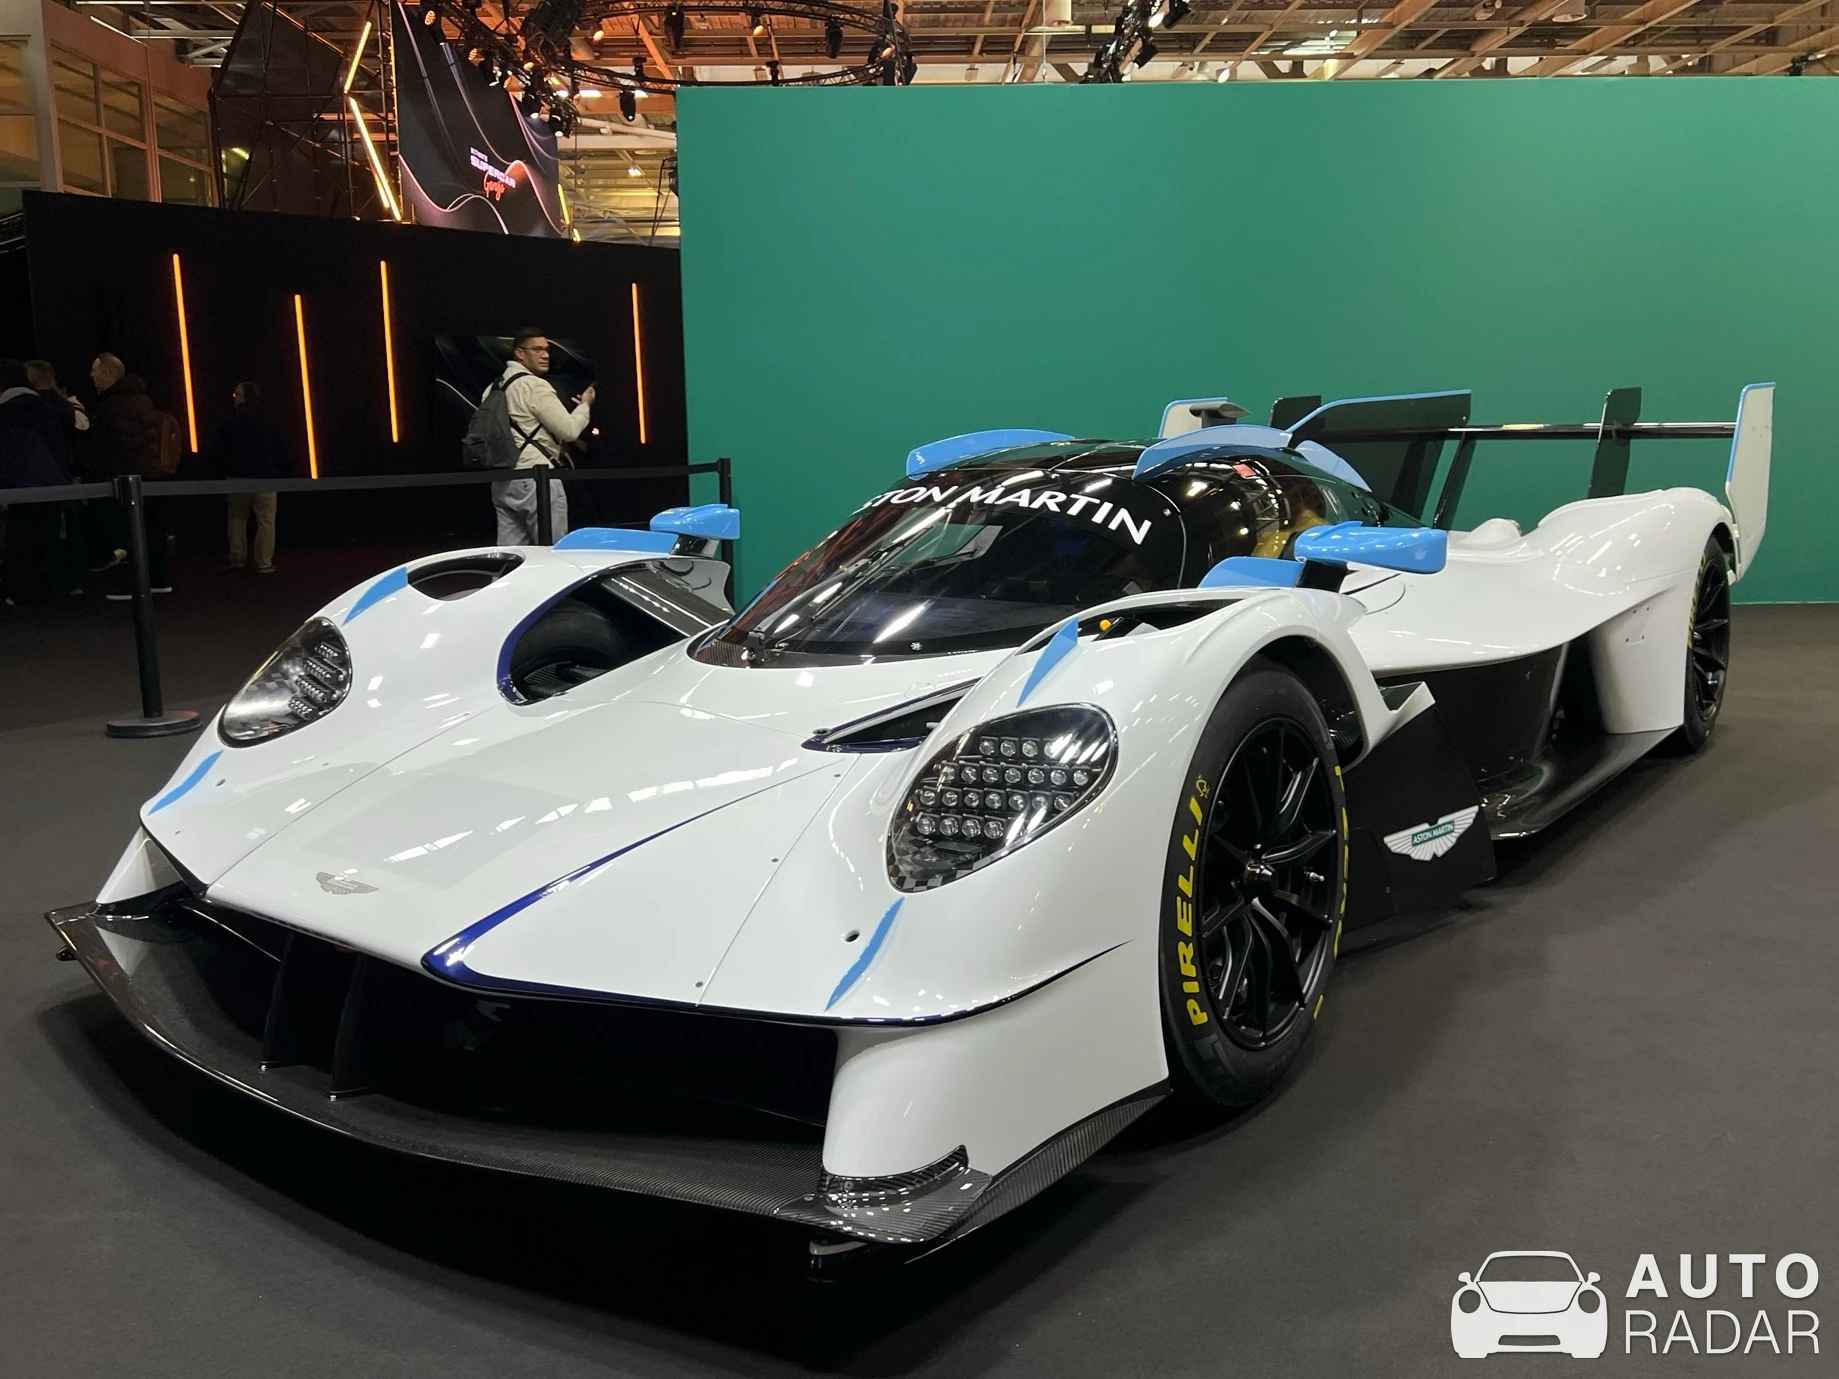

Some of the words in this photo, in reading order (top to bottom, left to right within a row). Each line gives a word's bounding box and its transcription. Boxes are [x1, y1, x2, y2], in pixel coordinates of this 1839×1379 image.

[848, 486, 959, 518] STON
[955, 485, 1152, 545] MARTIN
[1412, 830, 1432, 844] ASTON
[1176, 796, 1211, 1026] PIRELLI
